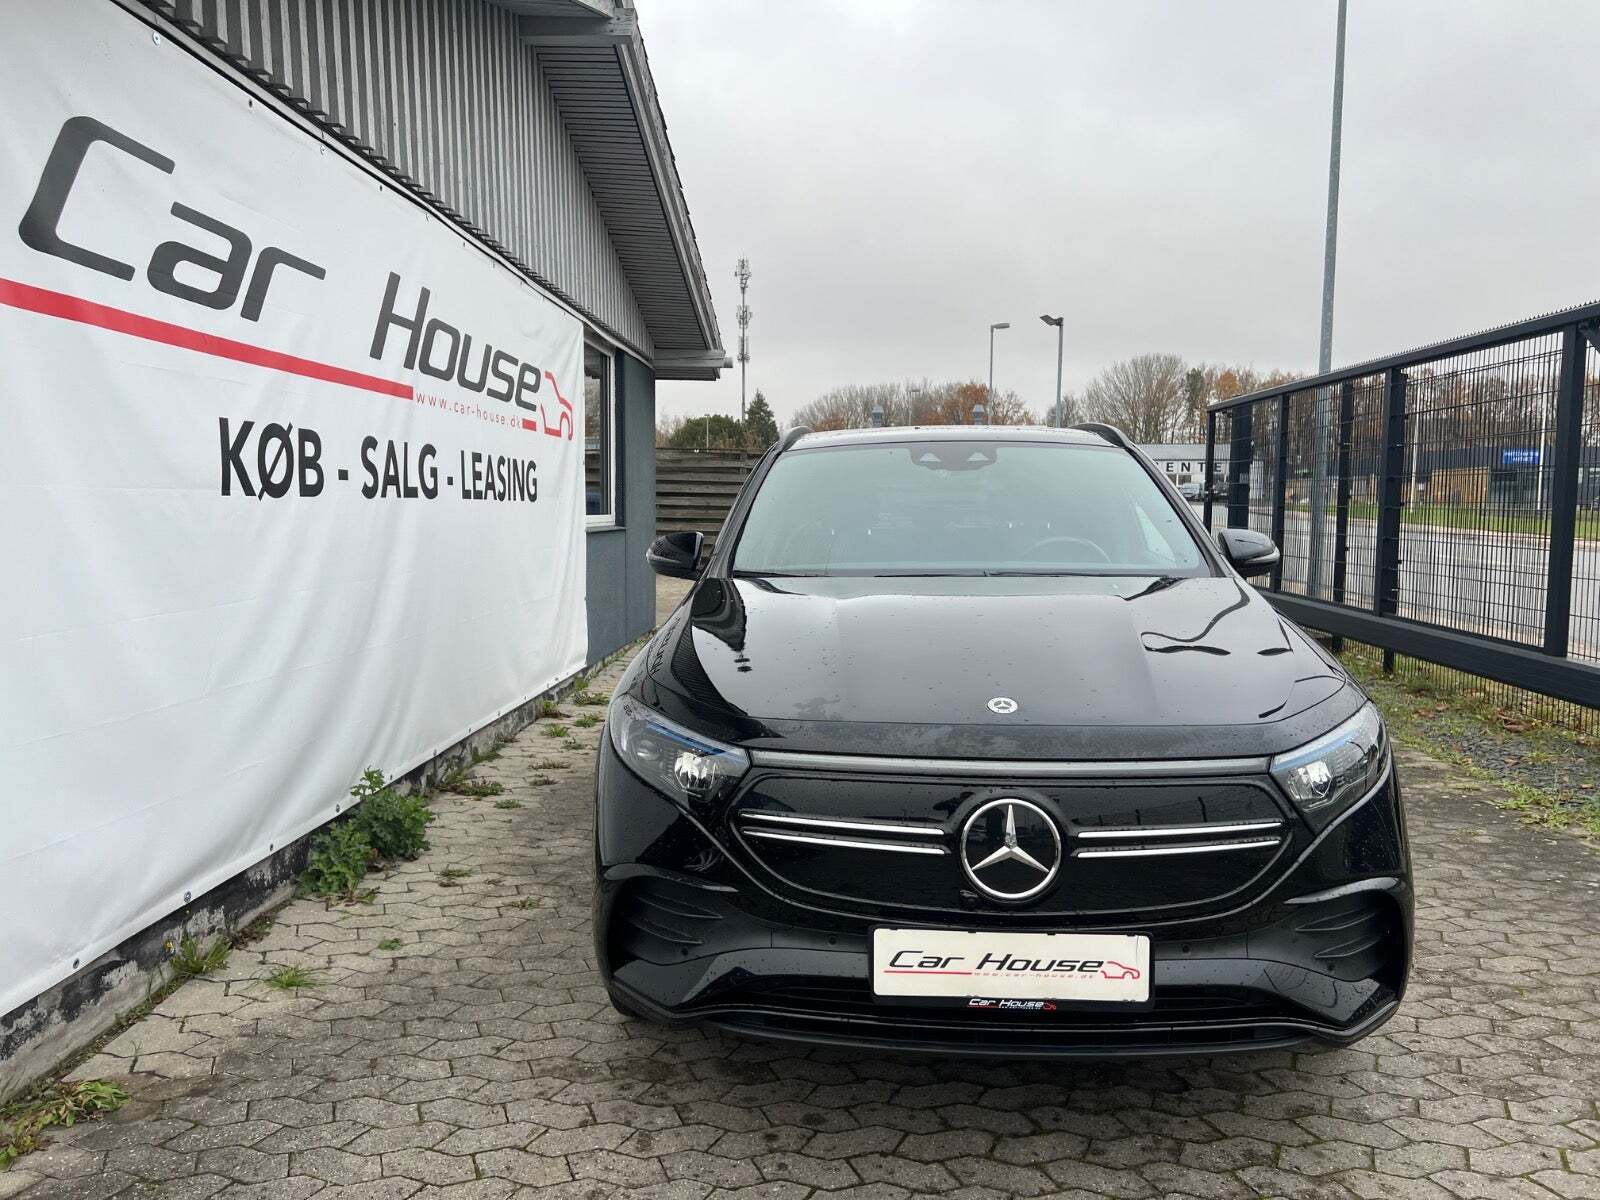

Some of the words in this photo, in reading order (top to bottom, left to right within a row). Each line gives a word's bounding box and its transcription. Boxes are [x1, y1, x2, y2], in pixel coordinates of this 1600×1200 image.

[18, 116, 326, 321] Car
[369, 272, 541, 412] House
[416, 391, 522, 430] www.car-house.dk
[219, 417, 325, 500] KØB
[361, 435, 438, 499] SALG
[460, 450, 538, 502] LEASING
[1156, 461, 1222, 473] ENTE
[889, 950, 965, 968] Car
[976, 952, 1104, 973] House
[968, 998, 996, 1006] Car
[999, 999, 1044, 1008] House
